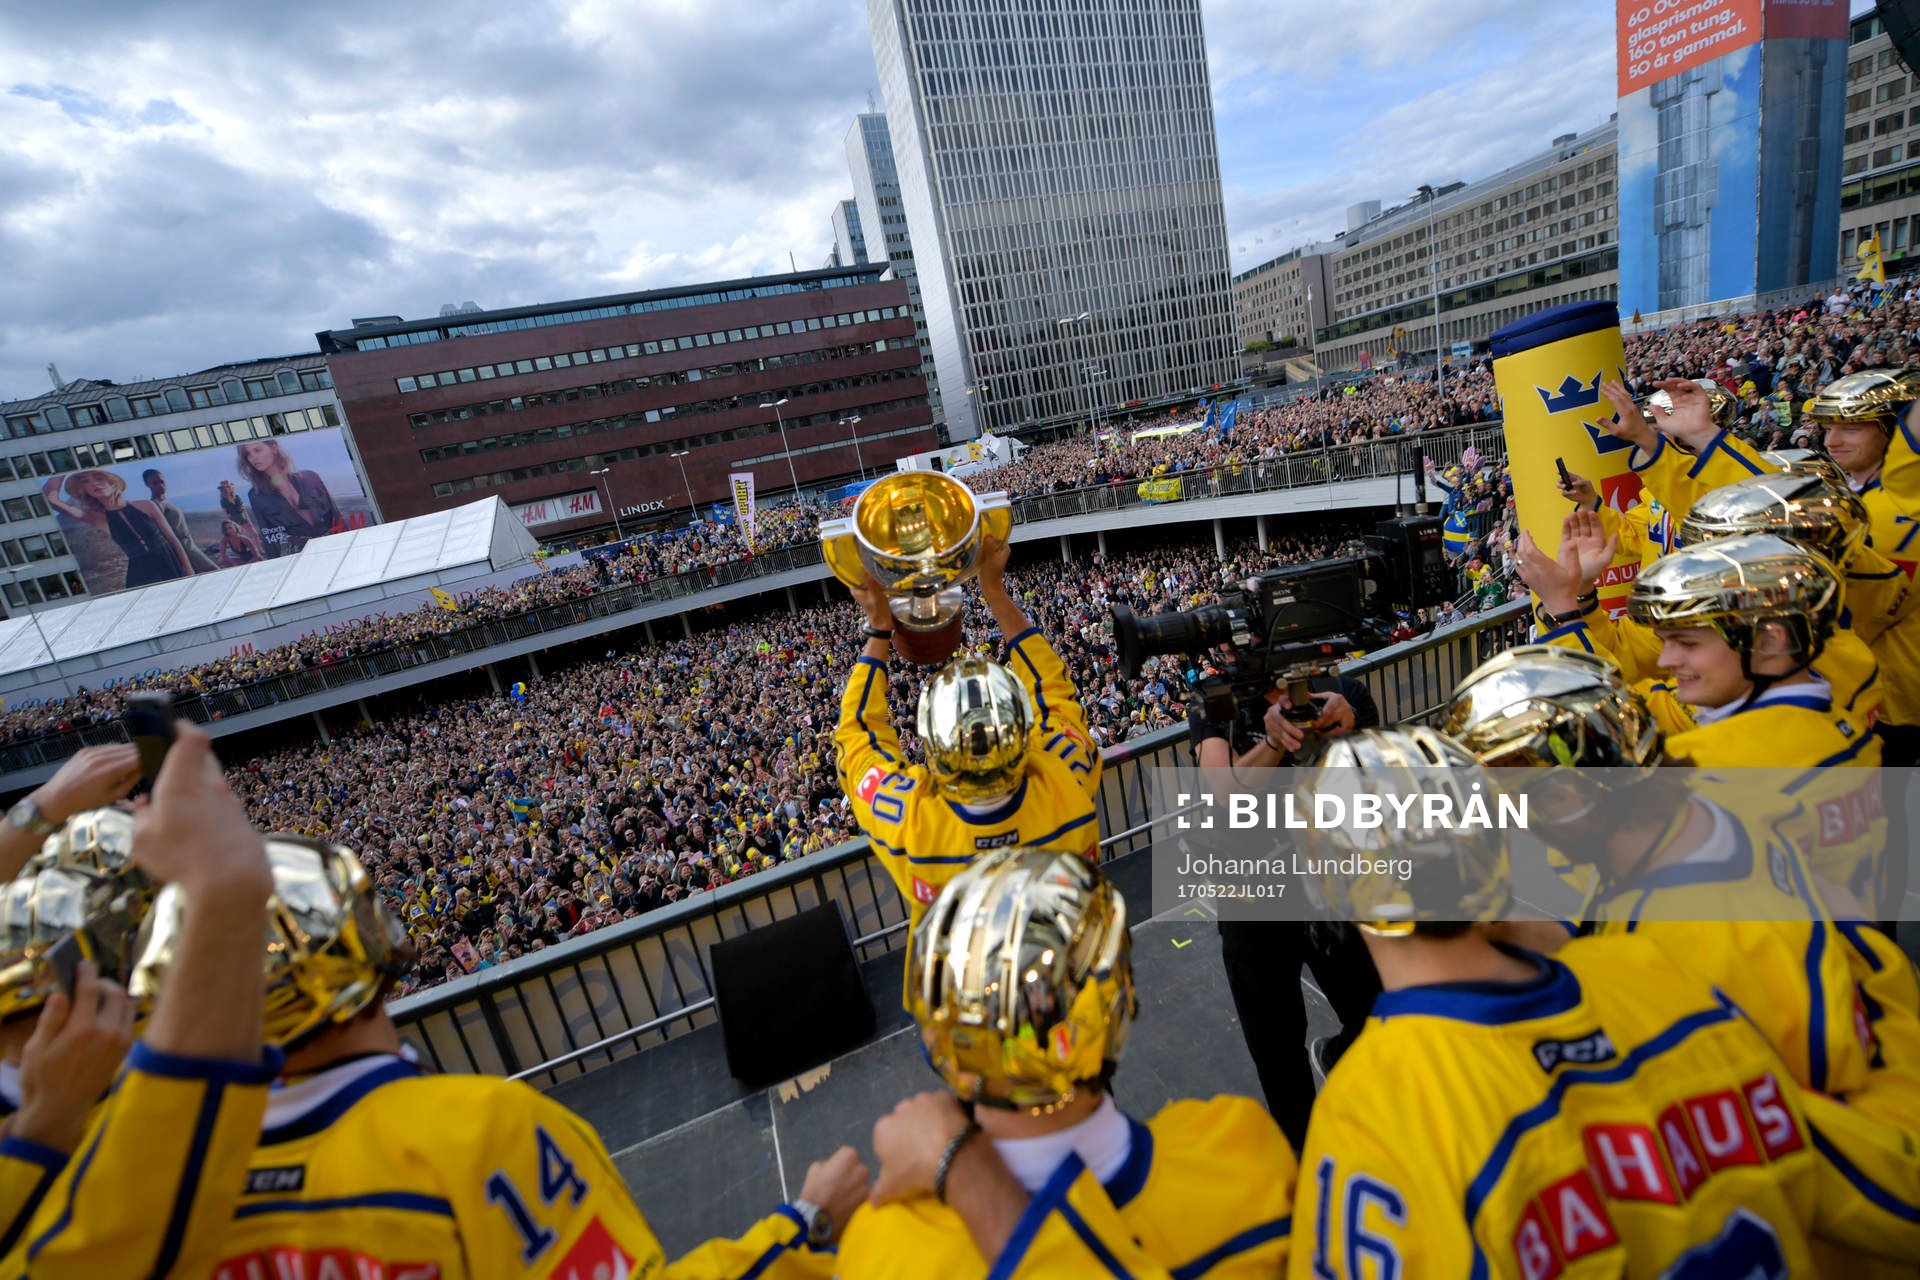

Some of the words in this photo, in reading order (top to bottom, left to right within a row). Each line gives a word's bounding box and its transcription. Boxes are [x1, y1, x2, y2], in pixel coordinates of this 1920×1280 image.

[1628, 8, 1651, 28] 60
[1628, 41, 1656, 63] 160
[1659, 28, 1687, 49] ton
[1689, 9, 1736, 34] tung.
[1629, 61, 1651, 80] 50
[1653, 53, 1671, 68] år
[1672, 18, 1747, 64] gammal.
[620, 499, 665, 517] LINDEX
[975, 831, 1019, 849] CCM
[484, 1123, 590, 1267] 14
[1312, 1155, 1408, 1280] 16
